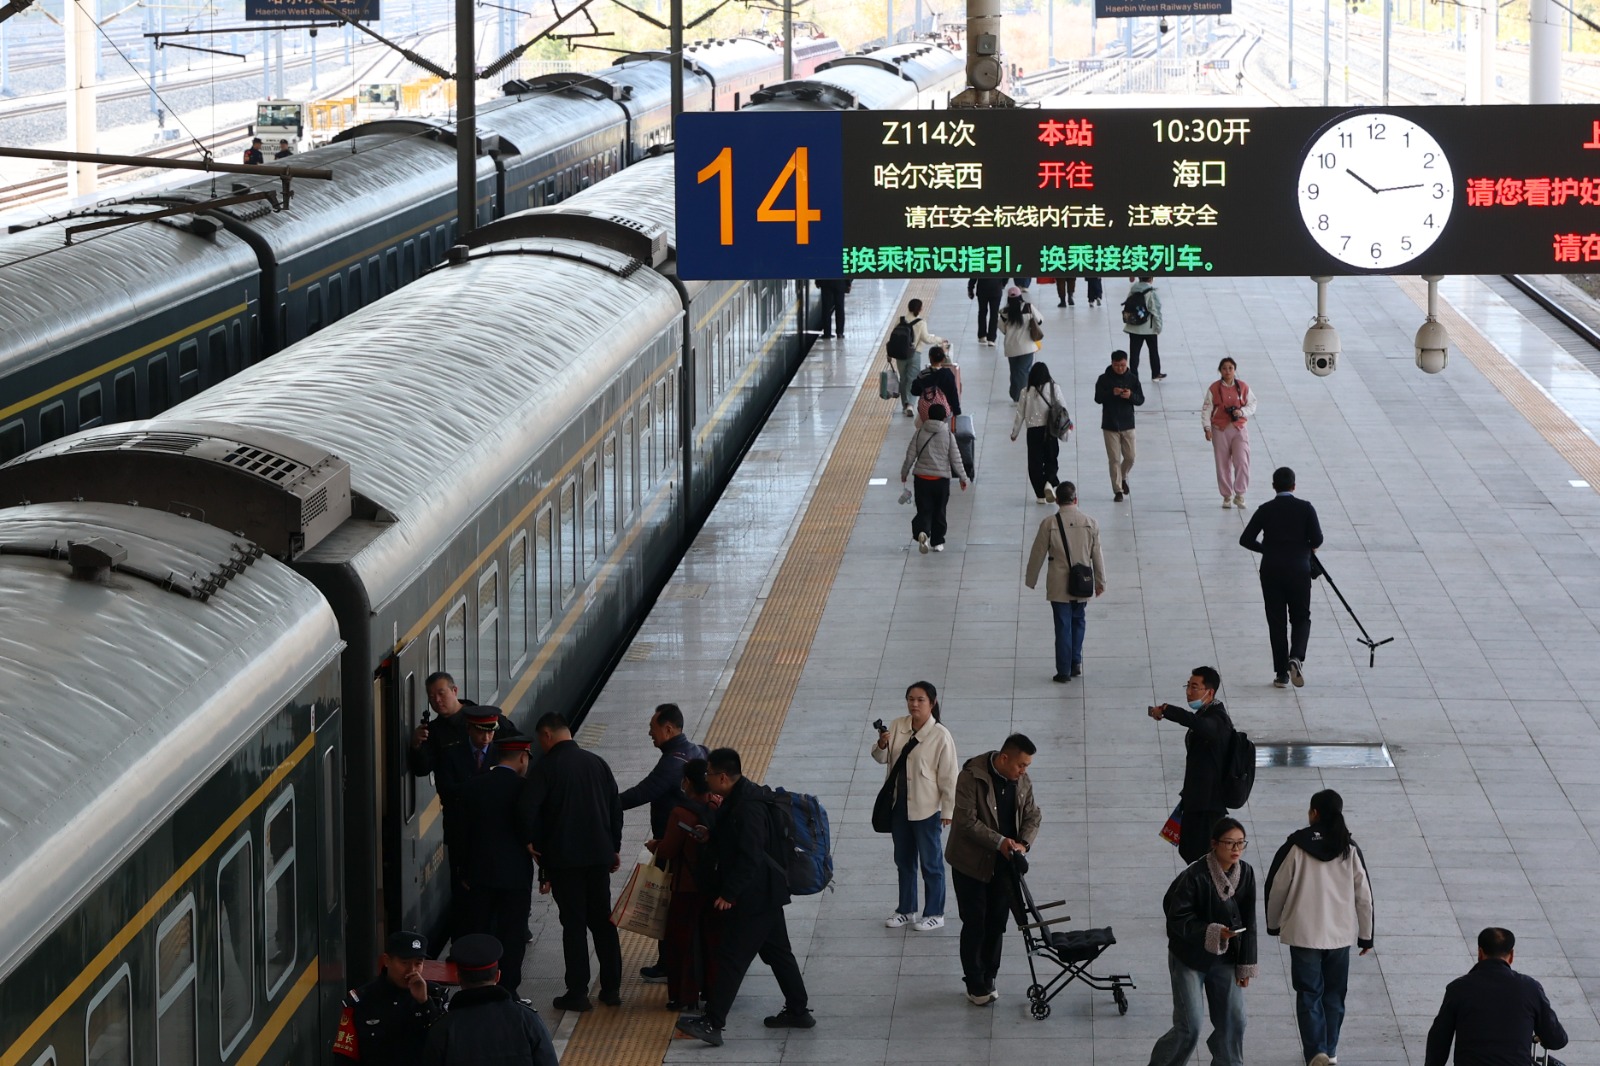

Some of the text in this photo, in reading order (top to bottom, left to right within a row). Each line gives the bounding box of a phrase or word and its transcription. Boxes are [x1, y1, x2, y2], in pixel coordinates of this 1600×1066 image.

[255, 8, 286, 16] Haerbin
[287, 8, 308, 16] West
[1138, 4, 1158, 12] West
[1160, 3, 1191, 12] Railway
[1193, 2, 1222, 10] Station
[882, 119, 976, 147] Z114次
[1038, 118, 1094, 147] 本站
[1152, 118, 1250, 145] 10:30开
[1367, 123, 1386, 140] 12
[1339, 132, 1352, 148] 11
[1403, 132, 1409, 148] 1
[1317, 153, 1336, 169] 10
[1423, 153, 1434, 169] 2
[874, 162, 983, 189] 哈尔滨西
[1037, 161, 1094, 189] 开往
[1172, 159, 1226, 187] 海口
[697, 147, 821, 246] 14
[1308, 184, 1320, 200] 9
[1432, 183, 1444, 199] 3
[1466, 177, 1600, 207] 请您看护好
[905, 203, 1218, 228] 请在安全标线内行走，注意安全
[1318, 214, 1329, 231] 8
[1423, 213, 1434, 229] 4
[1340, 236, 1351, 251] 7
[1370, 243, 1382, 259] 6
[1401, 236, 1412, 251] 5
[1552, 233, 1600, 262] 请在
